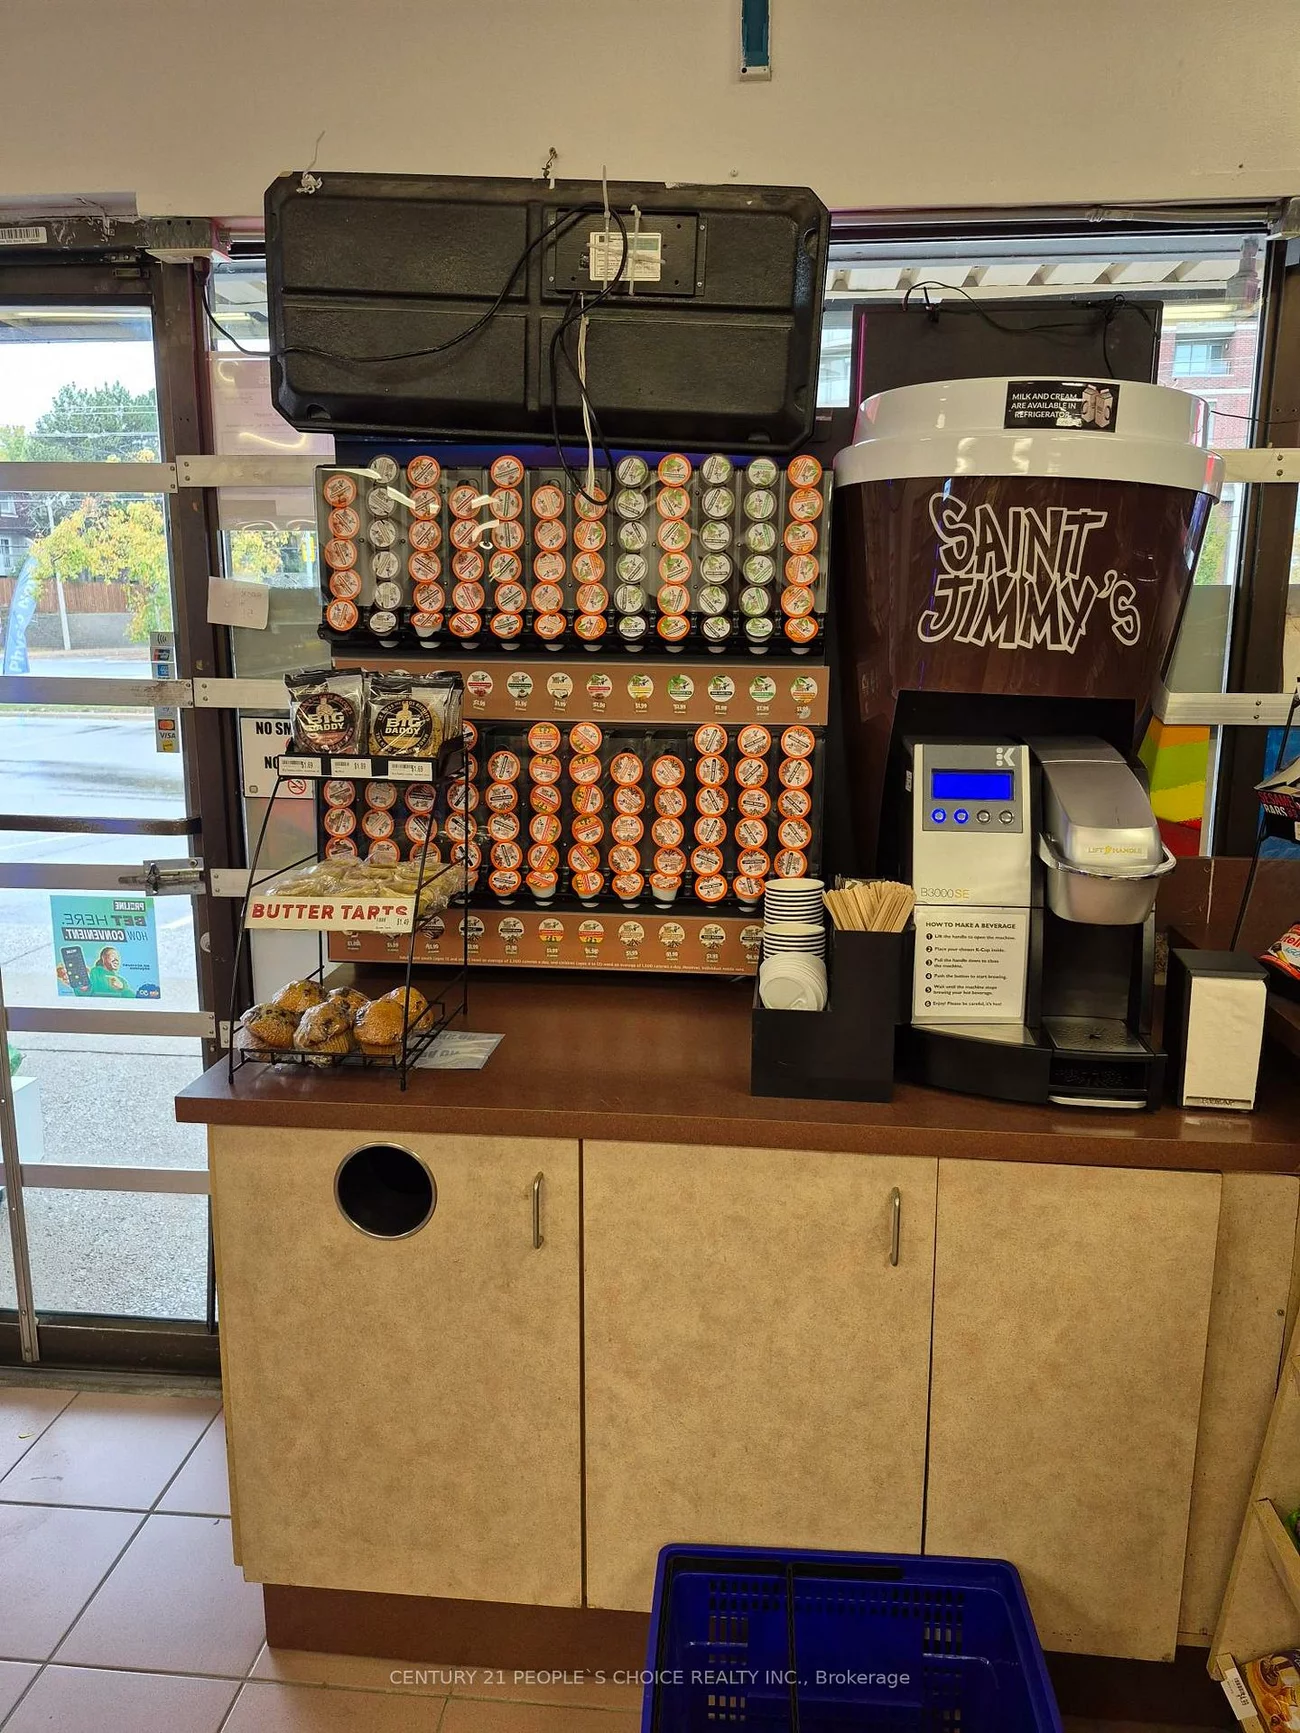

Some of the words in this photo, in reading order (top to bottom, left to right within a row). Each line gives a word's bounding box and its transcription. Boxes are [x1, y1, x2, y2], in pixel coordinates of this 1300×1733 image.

[929, 492, 1108, 582] SAINT
[918, 569, 1140, 654] JIMMY'S
[307, 711, 345, 724] BIG
[386, 717, 422, 728] BIG
[256, 721, 272, 735] NO
[306, 723, 345, 732] DADDY
[385, 727, 421, 735] DADDY
[252, 903, 334, 920] BUTTER
[340, 904, 408, 920] TARTS
